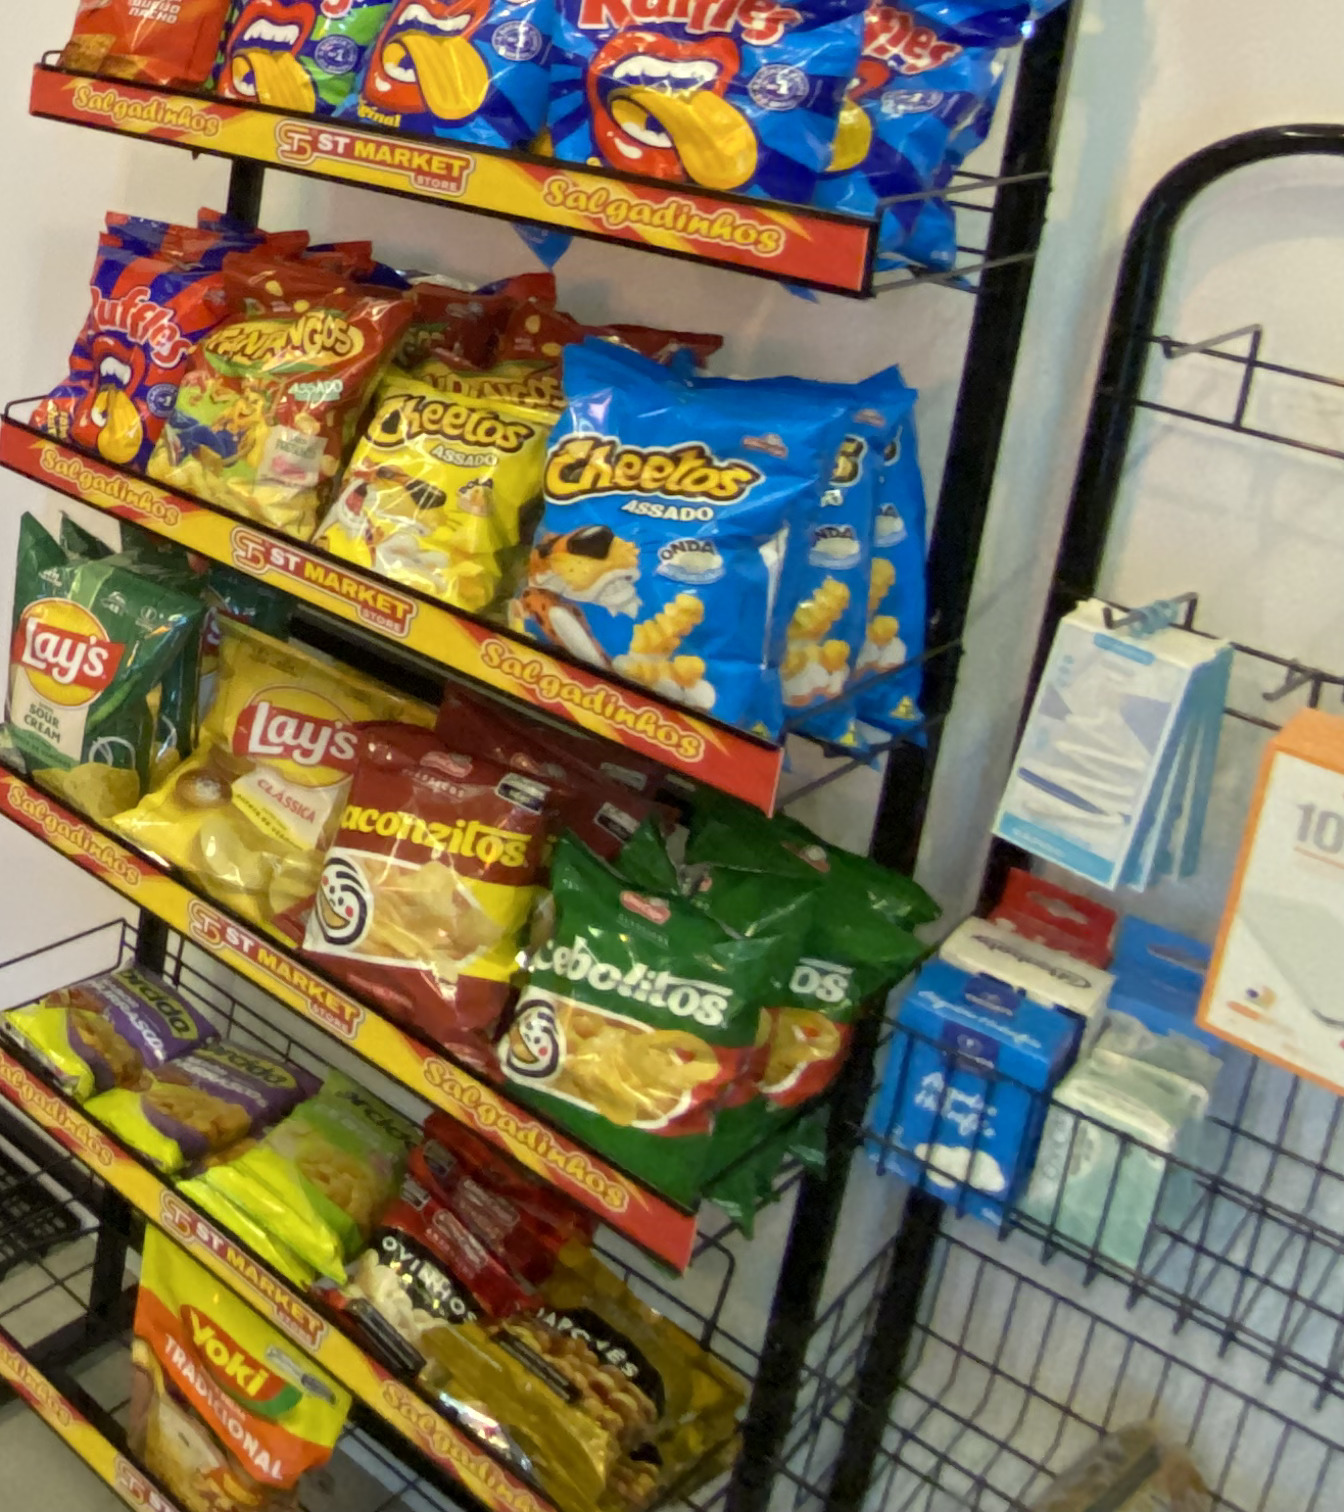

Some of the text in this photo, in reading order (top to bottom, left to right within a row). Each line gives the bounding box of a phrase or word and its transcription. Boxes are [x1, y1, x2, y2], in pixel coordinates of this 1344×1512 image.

[74, 87, 221, 137] Salgadinhos
[317, 133, 468, 179] ST MARKET
[415, 175, 458, 193] STORE
[543, 176, 785, 256] Salgadinhos
[365, 394, 535, 453] Cheetos
[430, 444, 499, 468] ASSADO
[40, 448, 182, 527] Salgadinhos
[546, 433, 764, 504] Cheetos
[620, 499, 714, 522] ASSADO
[814, 525, 857, 542] NDA
[660, 538, 714, 563] ONDA
[272, 548, 411, 622] ST MARKET
[21, 617, 109, 684] Lay's
[361, 606, 406, 637] STORE
[23, 714, 62, 744] CREAM
[29, 702, 61, 727] SOUR
[480, 638, 706, 763] Salgadinhos
[248, 701, 358, 766] Lay's
[8, 781, 141, 887] Salgadinhos
[340, 803, 532, 868] aconzitos
[220, 918, 362, 1021] ST MARKET
[315, 997, 358, 1037] STORE
[424, 1056, 629, 1214] Salgadinhos
[195, 1224, 324, 1335] ST MARKET
[163, 1333, 283, 1481] TRADICIONAL
